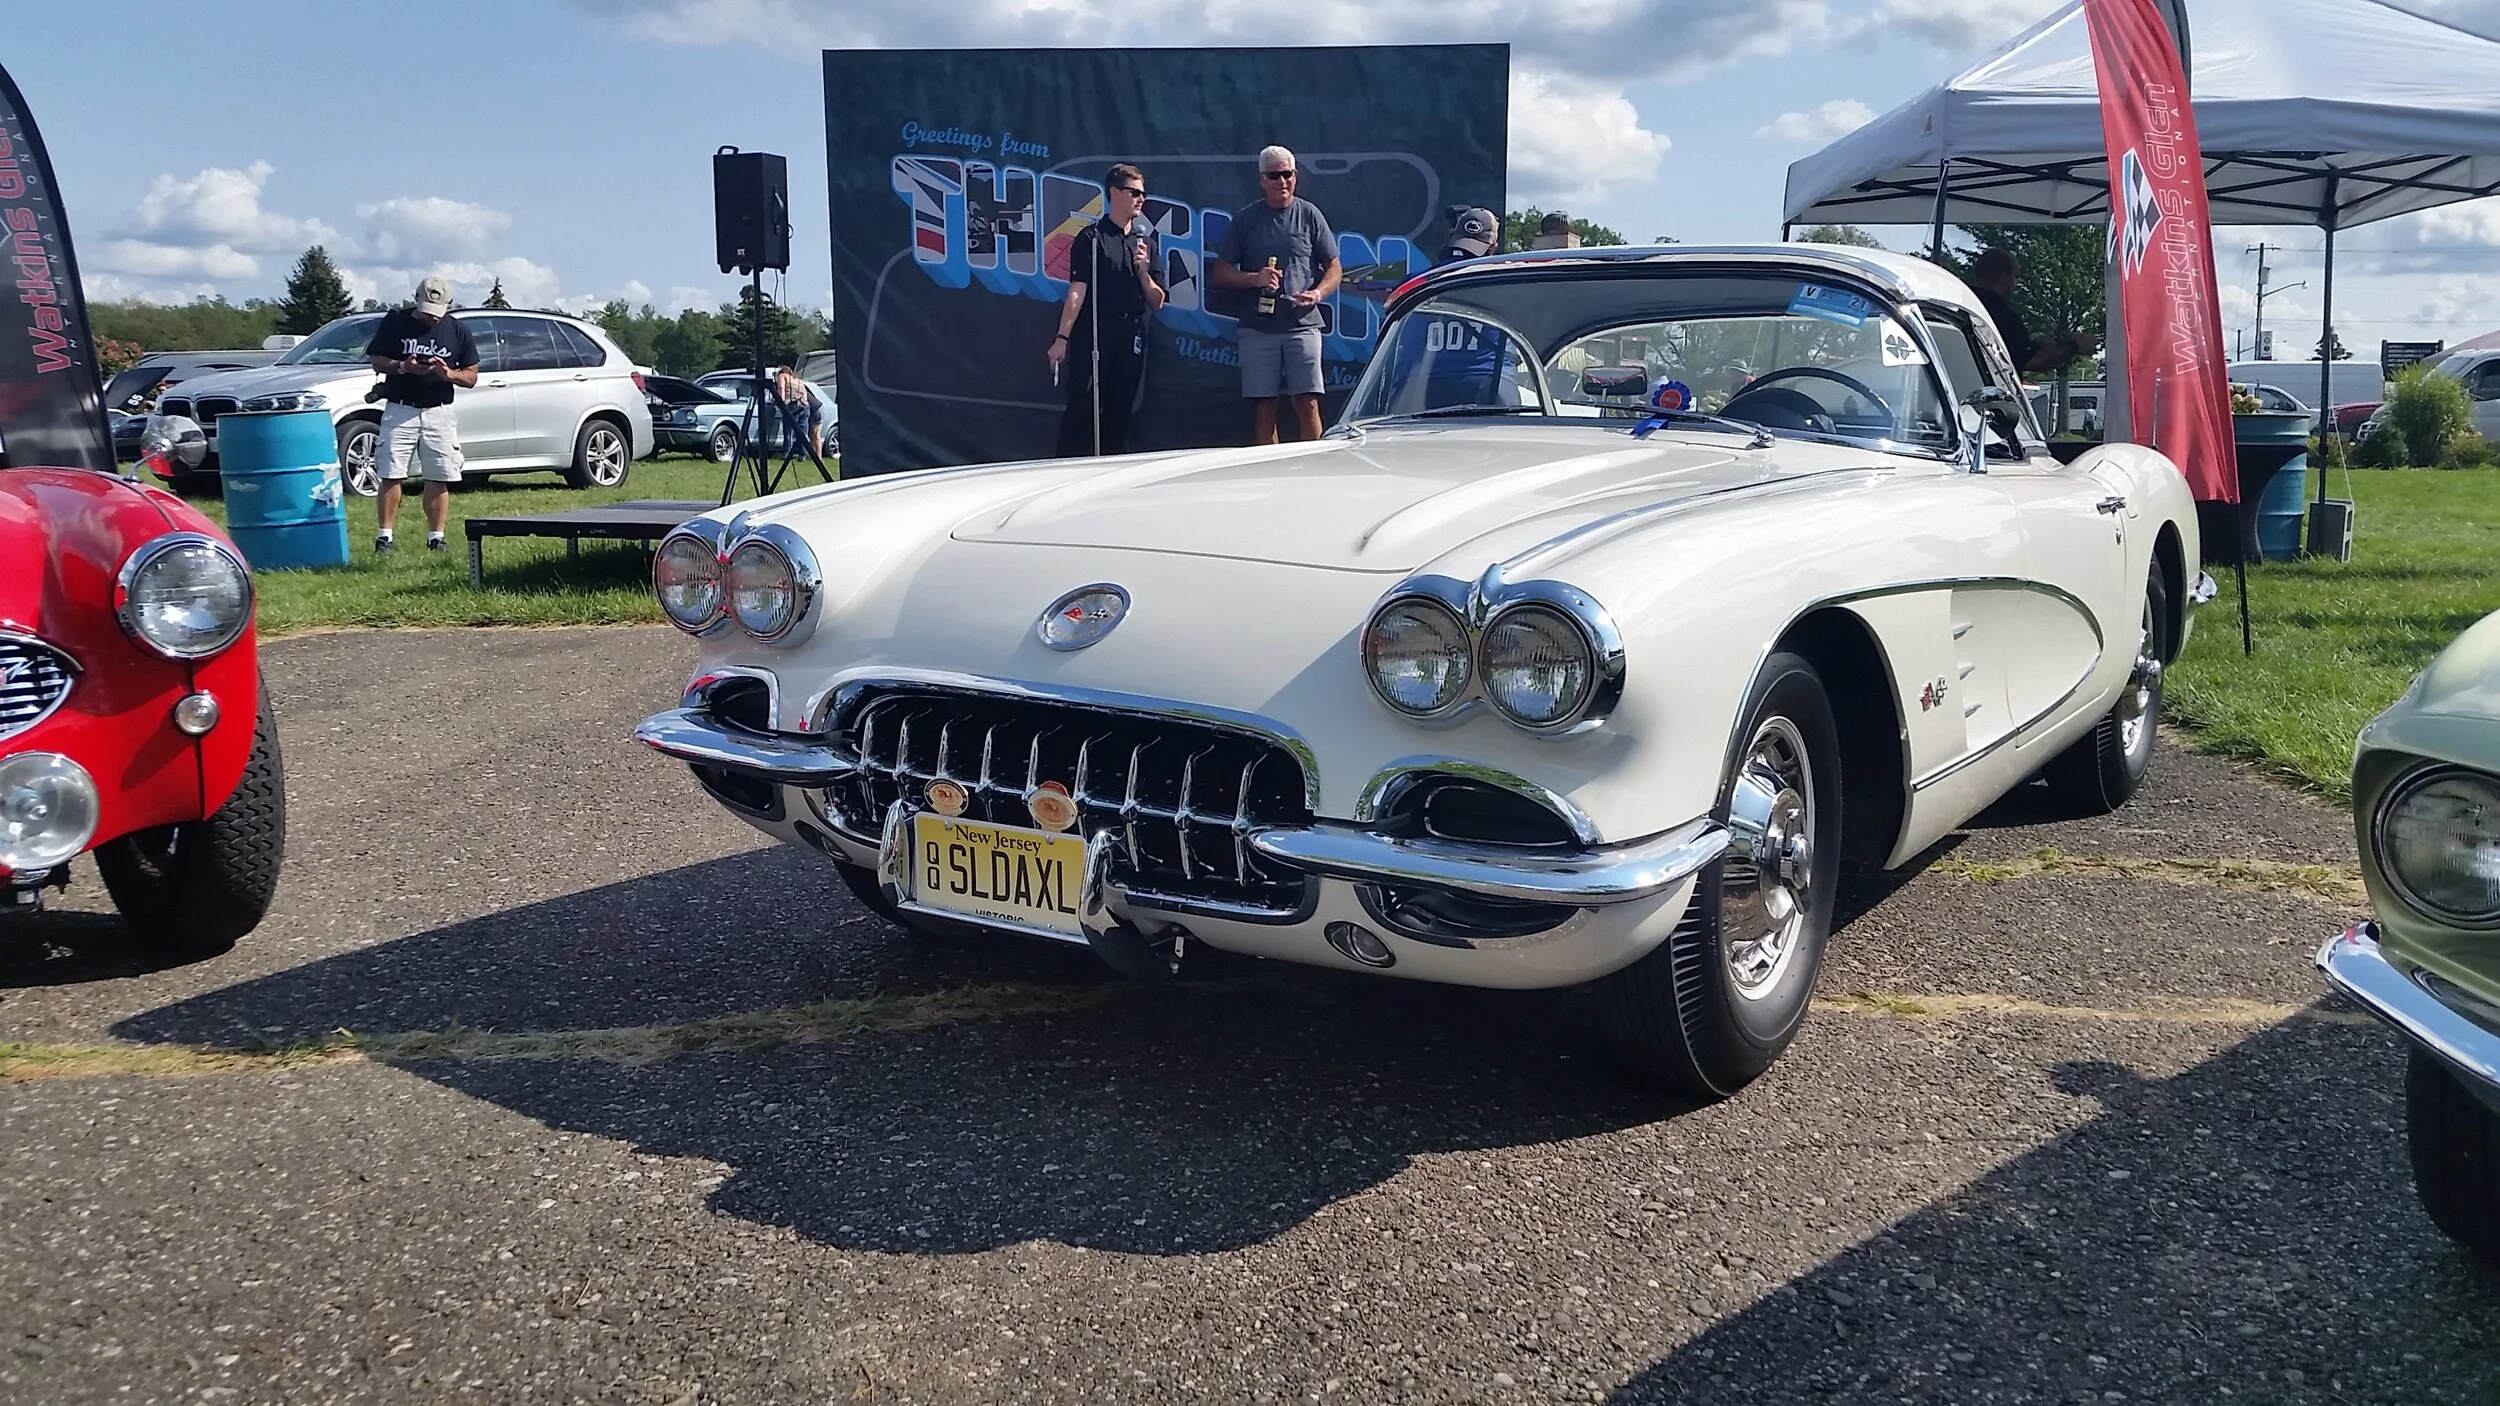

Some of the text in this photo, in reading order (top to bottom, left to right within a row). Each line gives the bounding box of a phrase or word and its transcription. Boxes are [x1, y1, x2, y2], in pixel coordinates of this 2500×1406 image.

[902, 121, 1050, 158] Greetings from
[6, 113, 83, 365] INTERNATIONAL
[2144, 82, 2200, 375] Watkins Glen
[5, 206, 72, 374] Watkins
[1175, 336, 1240, 367] Watki
[955, 824, 1042, 856] New Jersey
[949, 843, 1077, 915] SLDAXL
